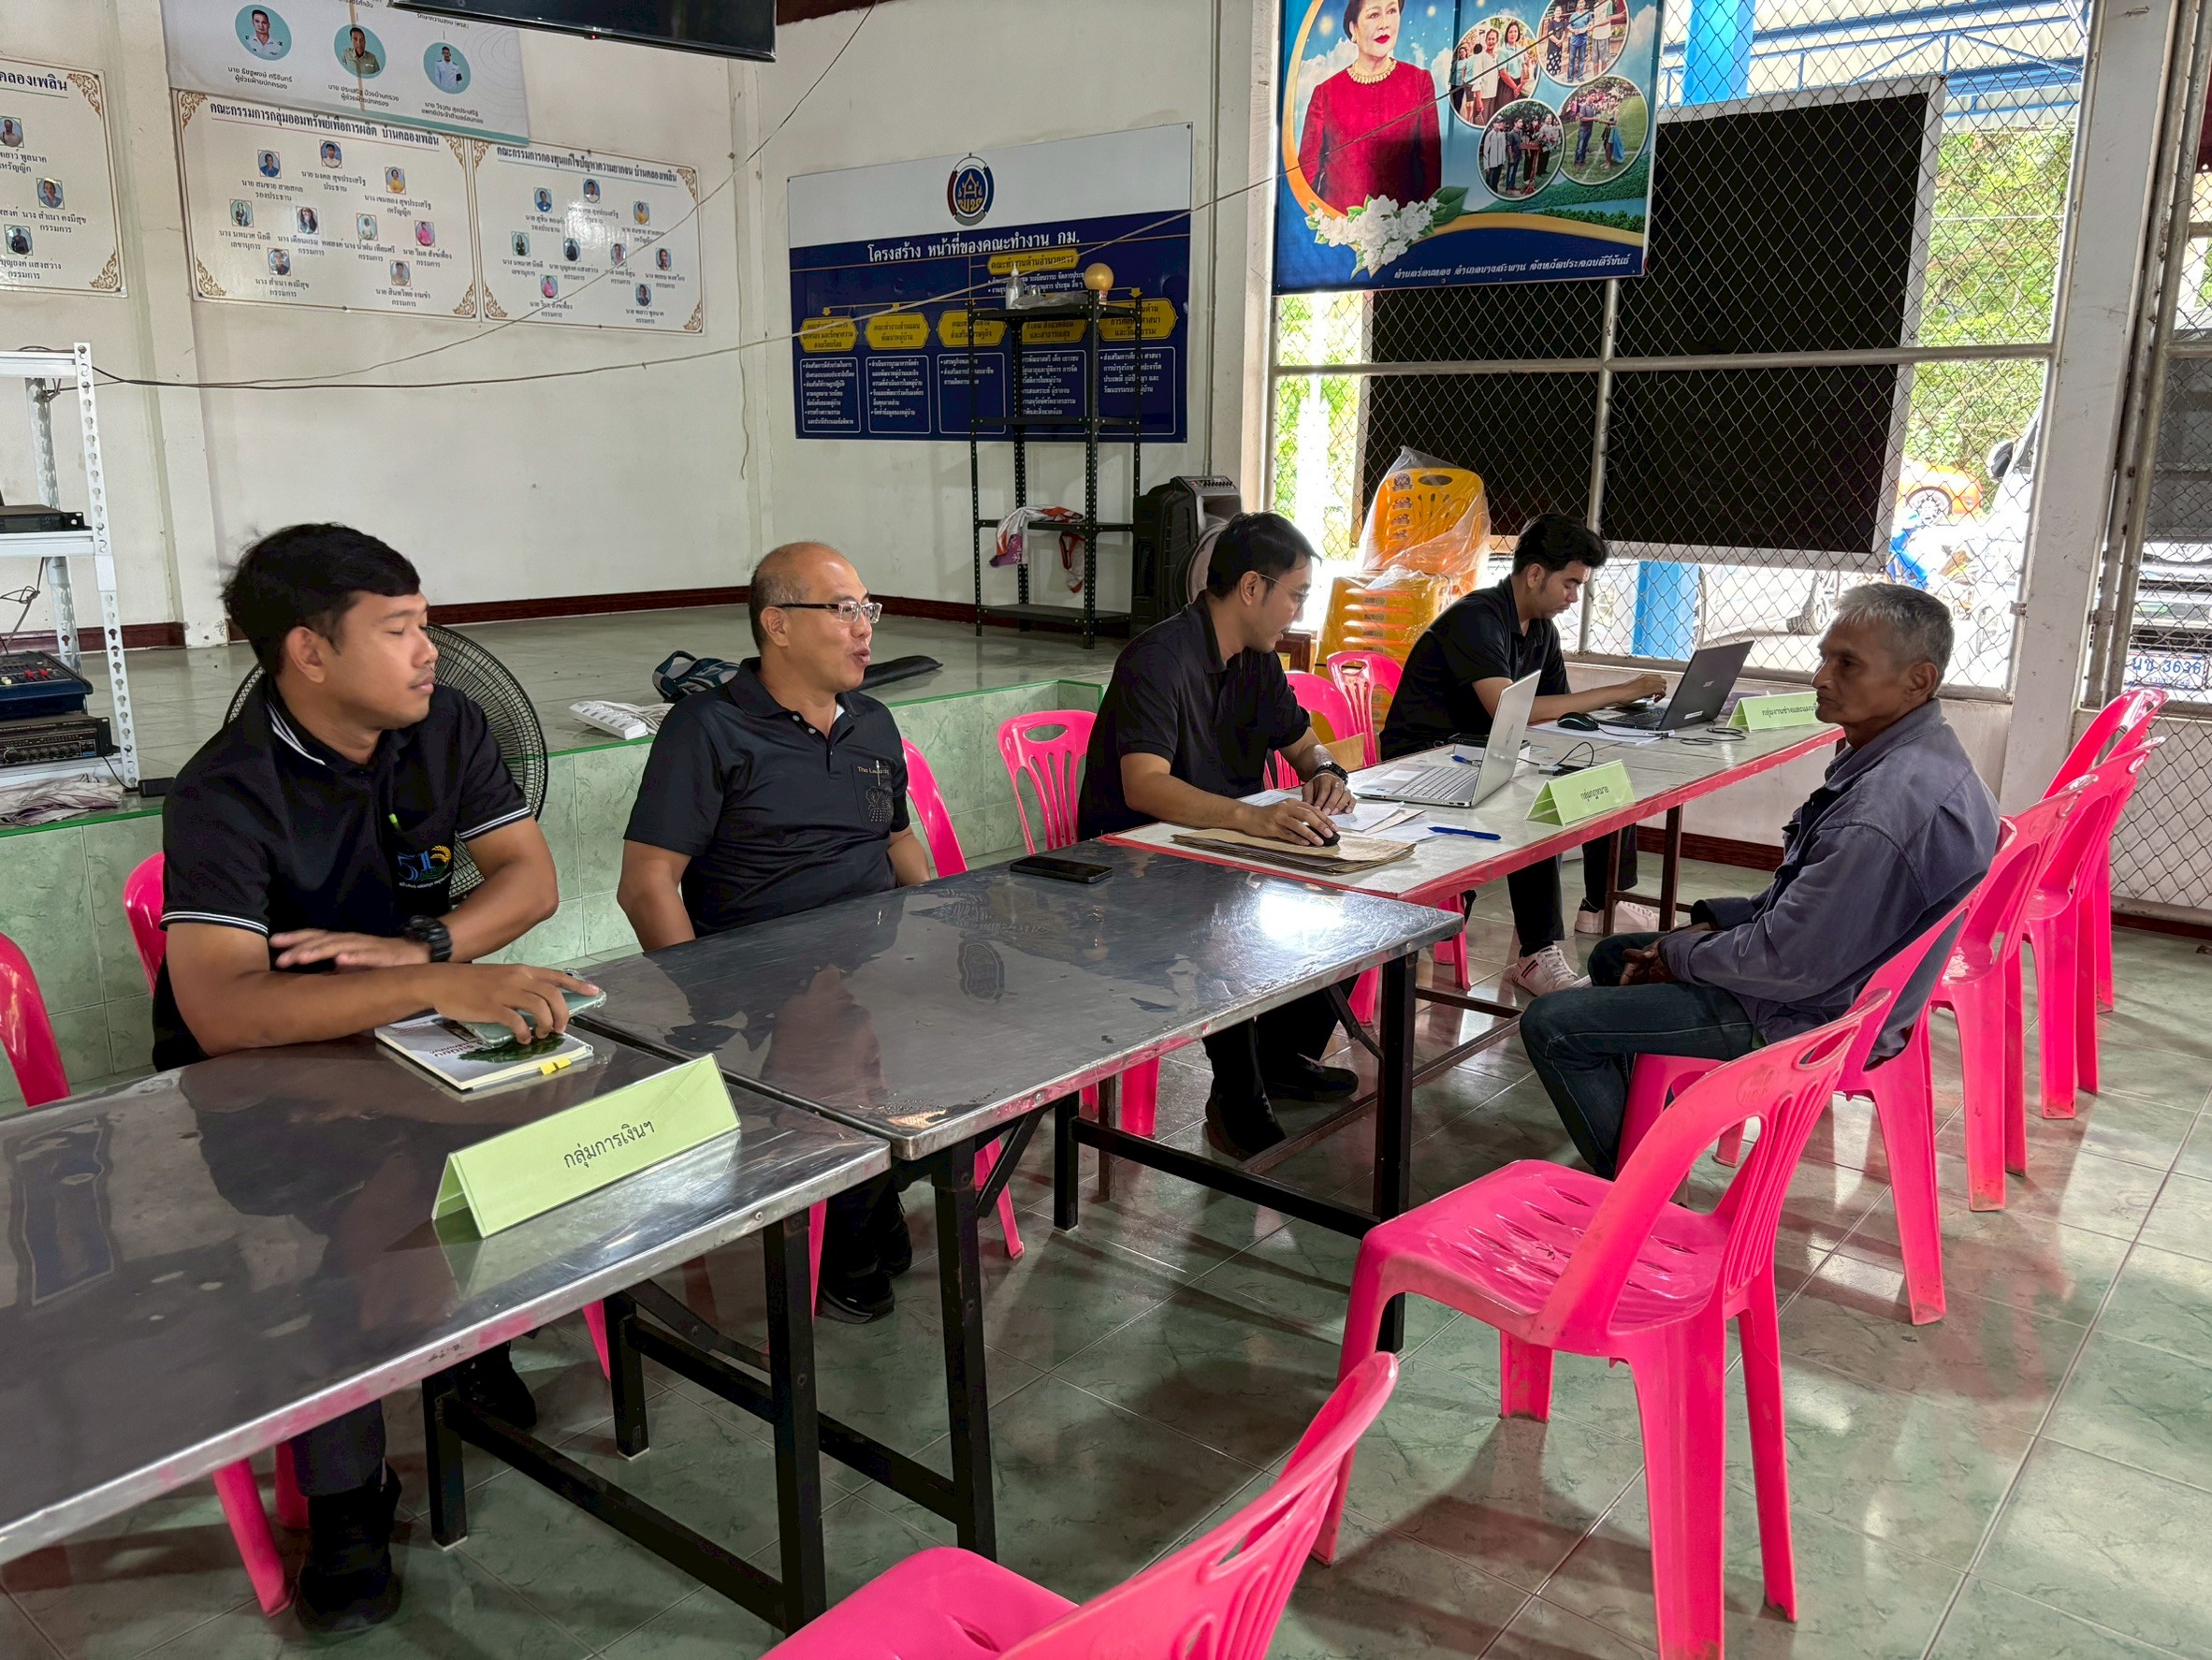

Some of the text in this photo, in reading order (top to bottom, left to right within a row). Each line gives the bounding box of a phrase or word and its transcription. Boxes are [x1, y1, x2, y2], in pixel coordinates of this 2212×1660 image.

[210, 103, 440, 146] คณะกรรมการกลุ่มออมทรัพย์เพื่อการผลิต บ้านคลองเพลิน
[301, 170, 313, 179] นาย
[241, 179, 255, 188] นาย
[323, 182, 347, 193] ประธาน
[255, 190, 292, 201] รองประธาน
[364, 194, 376, 202] นาง
[22, 211, 36, 220] นาง
[39, 225, 72, 234] กรรมการ
[219, 229, 231, 238] นาง
[277, 235, 289, 243] นาง
[230, 241, 261, 252] เลขานุการ
[344, 241, 356, 250] นาง
[866, 229, 1081, 263] โครงสร้าง หน้าที่ของคณะทำงาน กม.
[298, 247, 325, 256] กรรมการ
[357, 254, 384, 262] กรรมการ
[29, 257, 62, 269] แสงสว่าง
[415, 259, 441, 268] กรรมการ
[1393, 252, 1632, 280] ตำบลร่อนทอง อำเภอบางสะพาน จังหวัดประจวบคีรีขันธ์
[7, 270, 40, 280] กรรมการ
[255, 278, 268, 286] นาง
[269, 289, 298, 298] กรรมการ
[391, 299, 416, 308] กรรมการ
[563, 1118, 656, 1169] กลุ่มการเงินฯ
